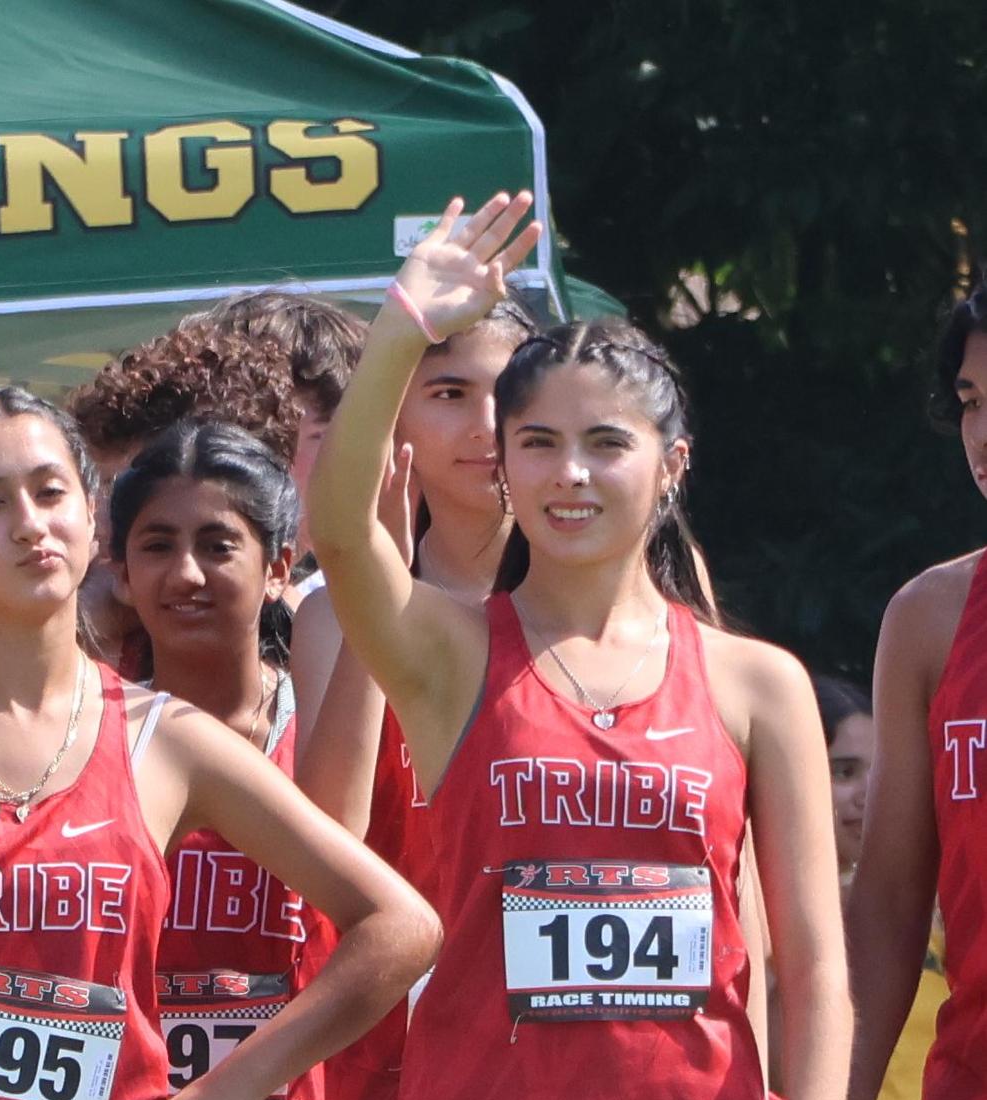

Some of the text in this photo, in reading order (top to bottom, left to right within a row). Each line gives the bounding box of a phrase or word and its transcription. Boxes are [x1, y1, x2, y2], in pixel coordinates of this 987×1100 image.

[490, 757, 714, 837] TRIBE
[163, 849, 307, 943] IBE
[545, 864, 670, 888] RTS
[538, 914, 679, 982] 194
[530, 992, 691, 1008] RACE TIMING
[166, 1024, 257, 1091] 97
